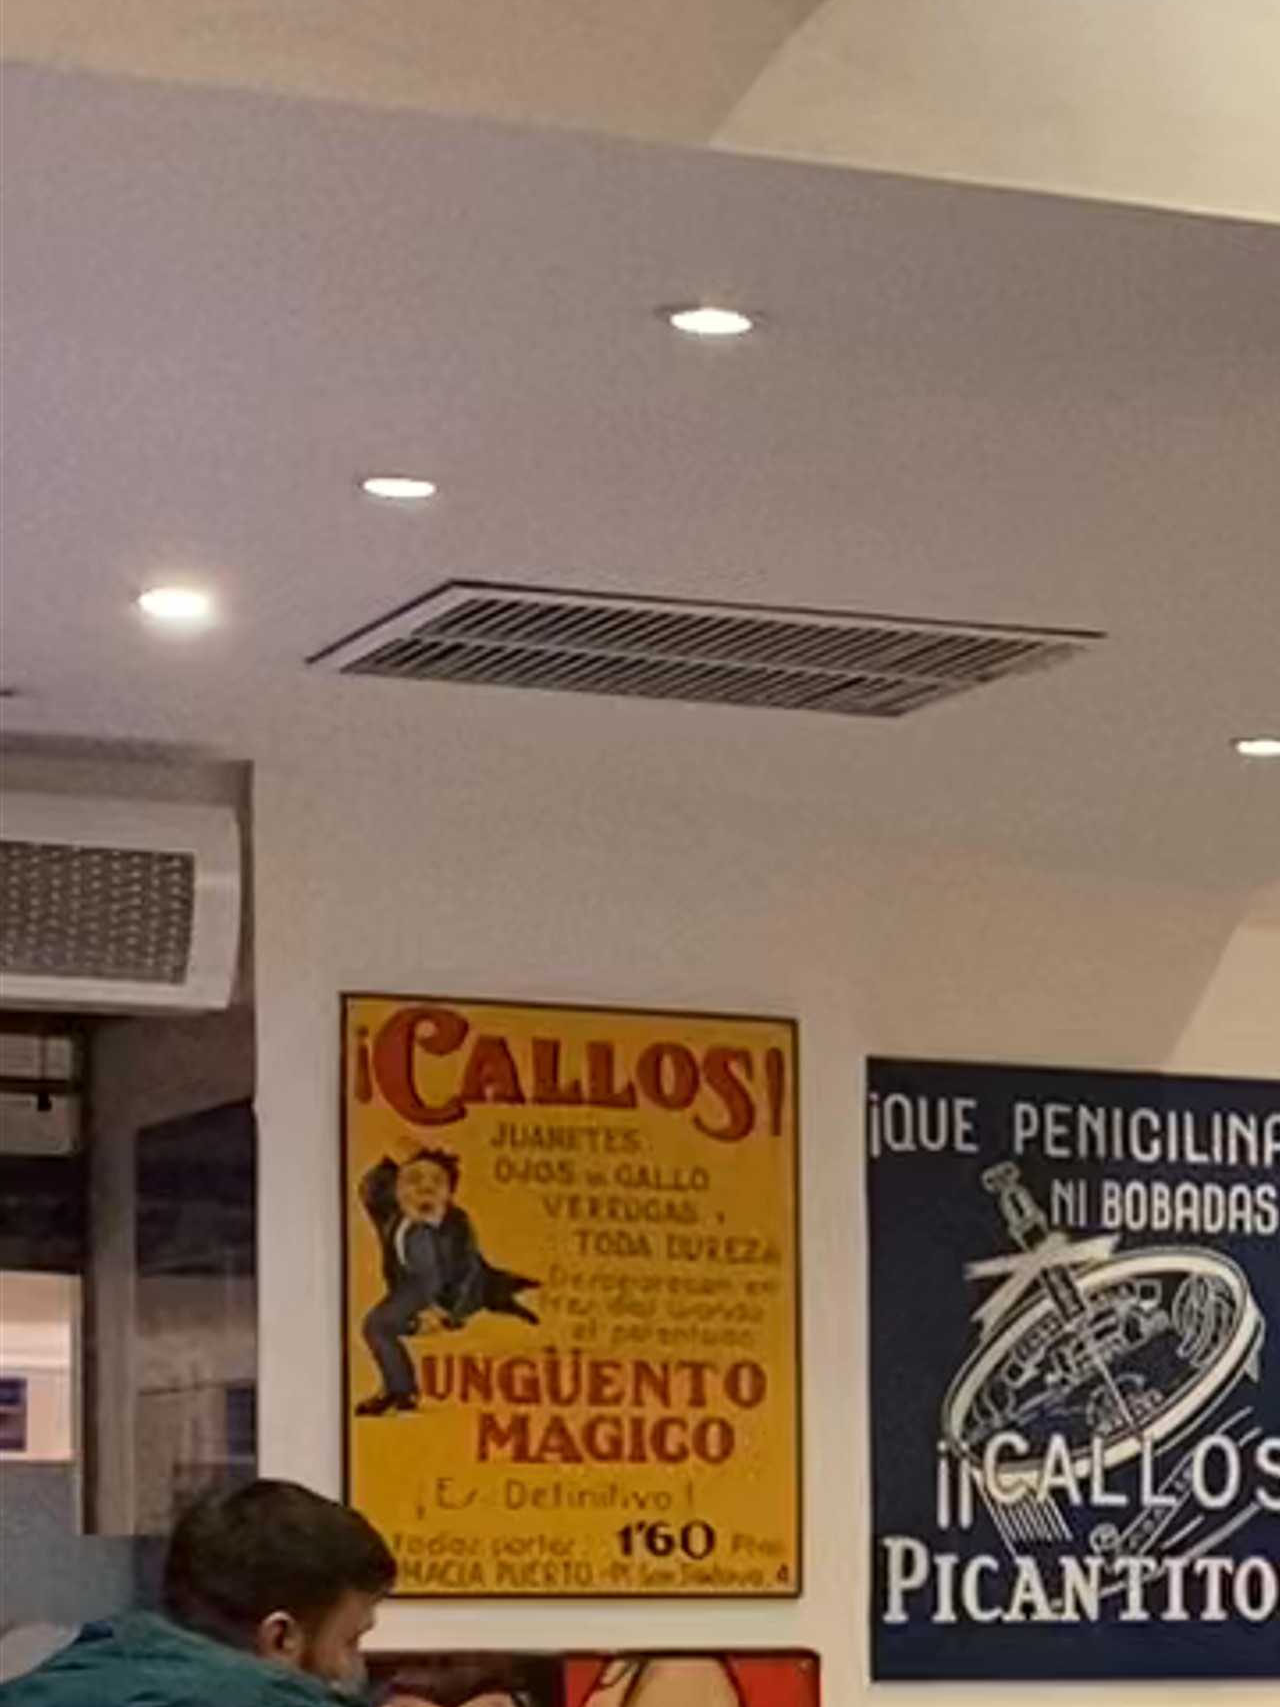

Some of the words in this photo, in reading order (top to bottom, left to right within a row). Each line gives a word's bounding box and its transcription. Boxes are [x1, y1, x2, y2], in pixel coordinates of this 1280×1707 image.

[355, 1006, 785, 1143] ¡CALLOS!
[870, 1092, 979, 1157] ¡QUE
[1051, 1179, 1087, 1227] NI
[422, 1346, 767, 1409] UNGÜENTO
[476, 1412, 736, 1465] MAGICO
